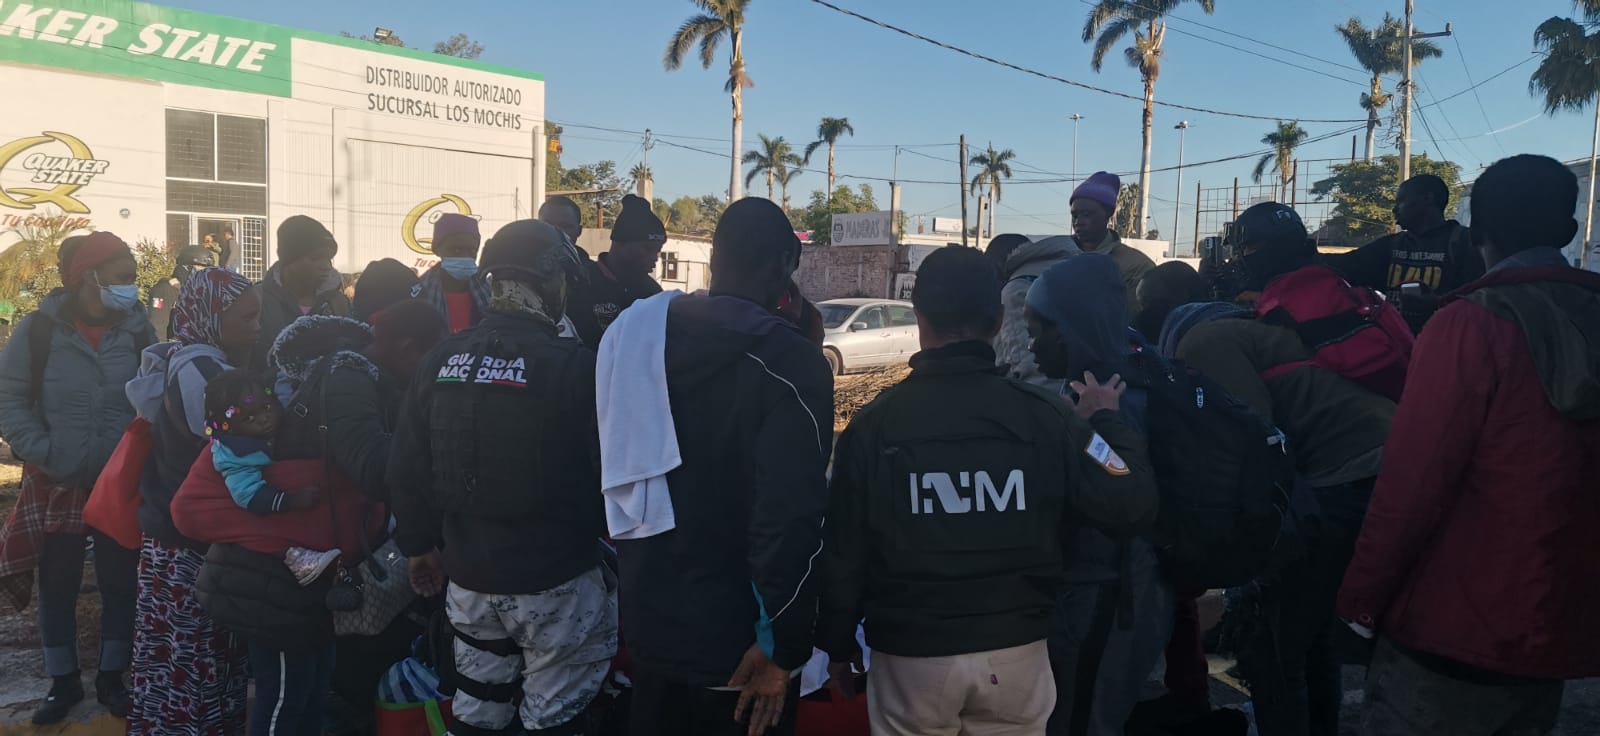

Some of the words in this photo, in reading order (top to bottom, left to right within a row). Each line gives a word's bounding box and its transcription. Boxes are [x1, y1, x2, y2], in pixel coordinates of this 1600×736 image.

[0, 4, 118, 49] KER
[127, 23, 277, 72] STATE
[366, 66, 449, 96] DISTRIBUIDOR
[453, 80, 522, 106] AUTORIZADO
[368, 93, 439, 119] SUCURSAL
[446, 104, 470, 123] LOS
[474, 108, 521, 130] MOCHIS
[23, 152, 110, 174] QUAKER
[31, 170, 95, 186] STATE
[438, 366, 527, 383] NACONAL
[910, 469, 1026, 514] INM
